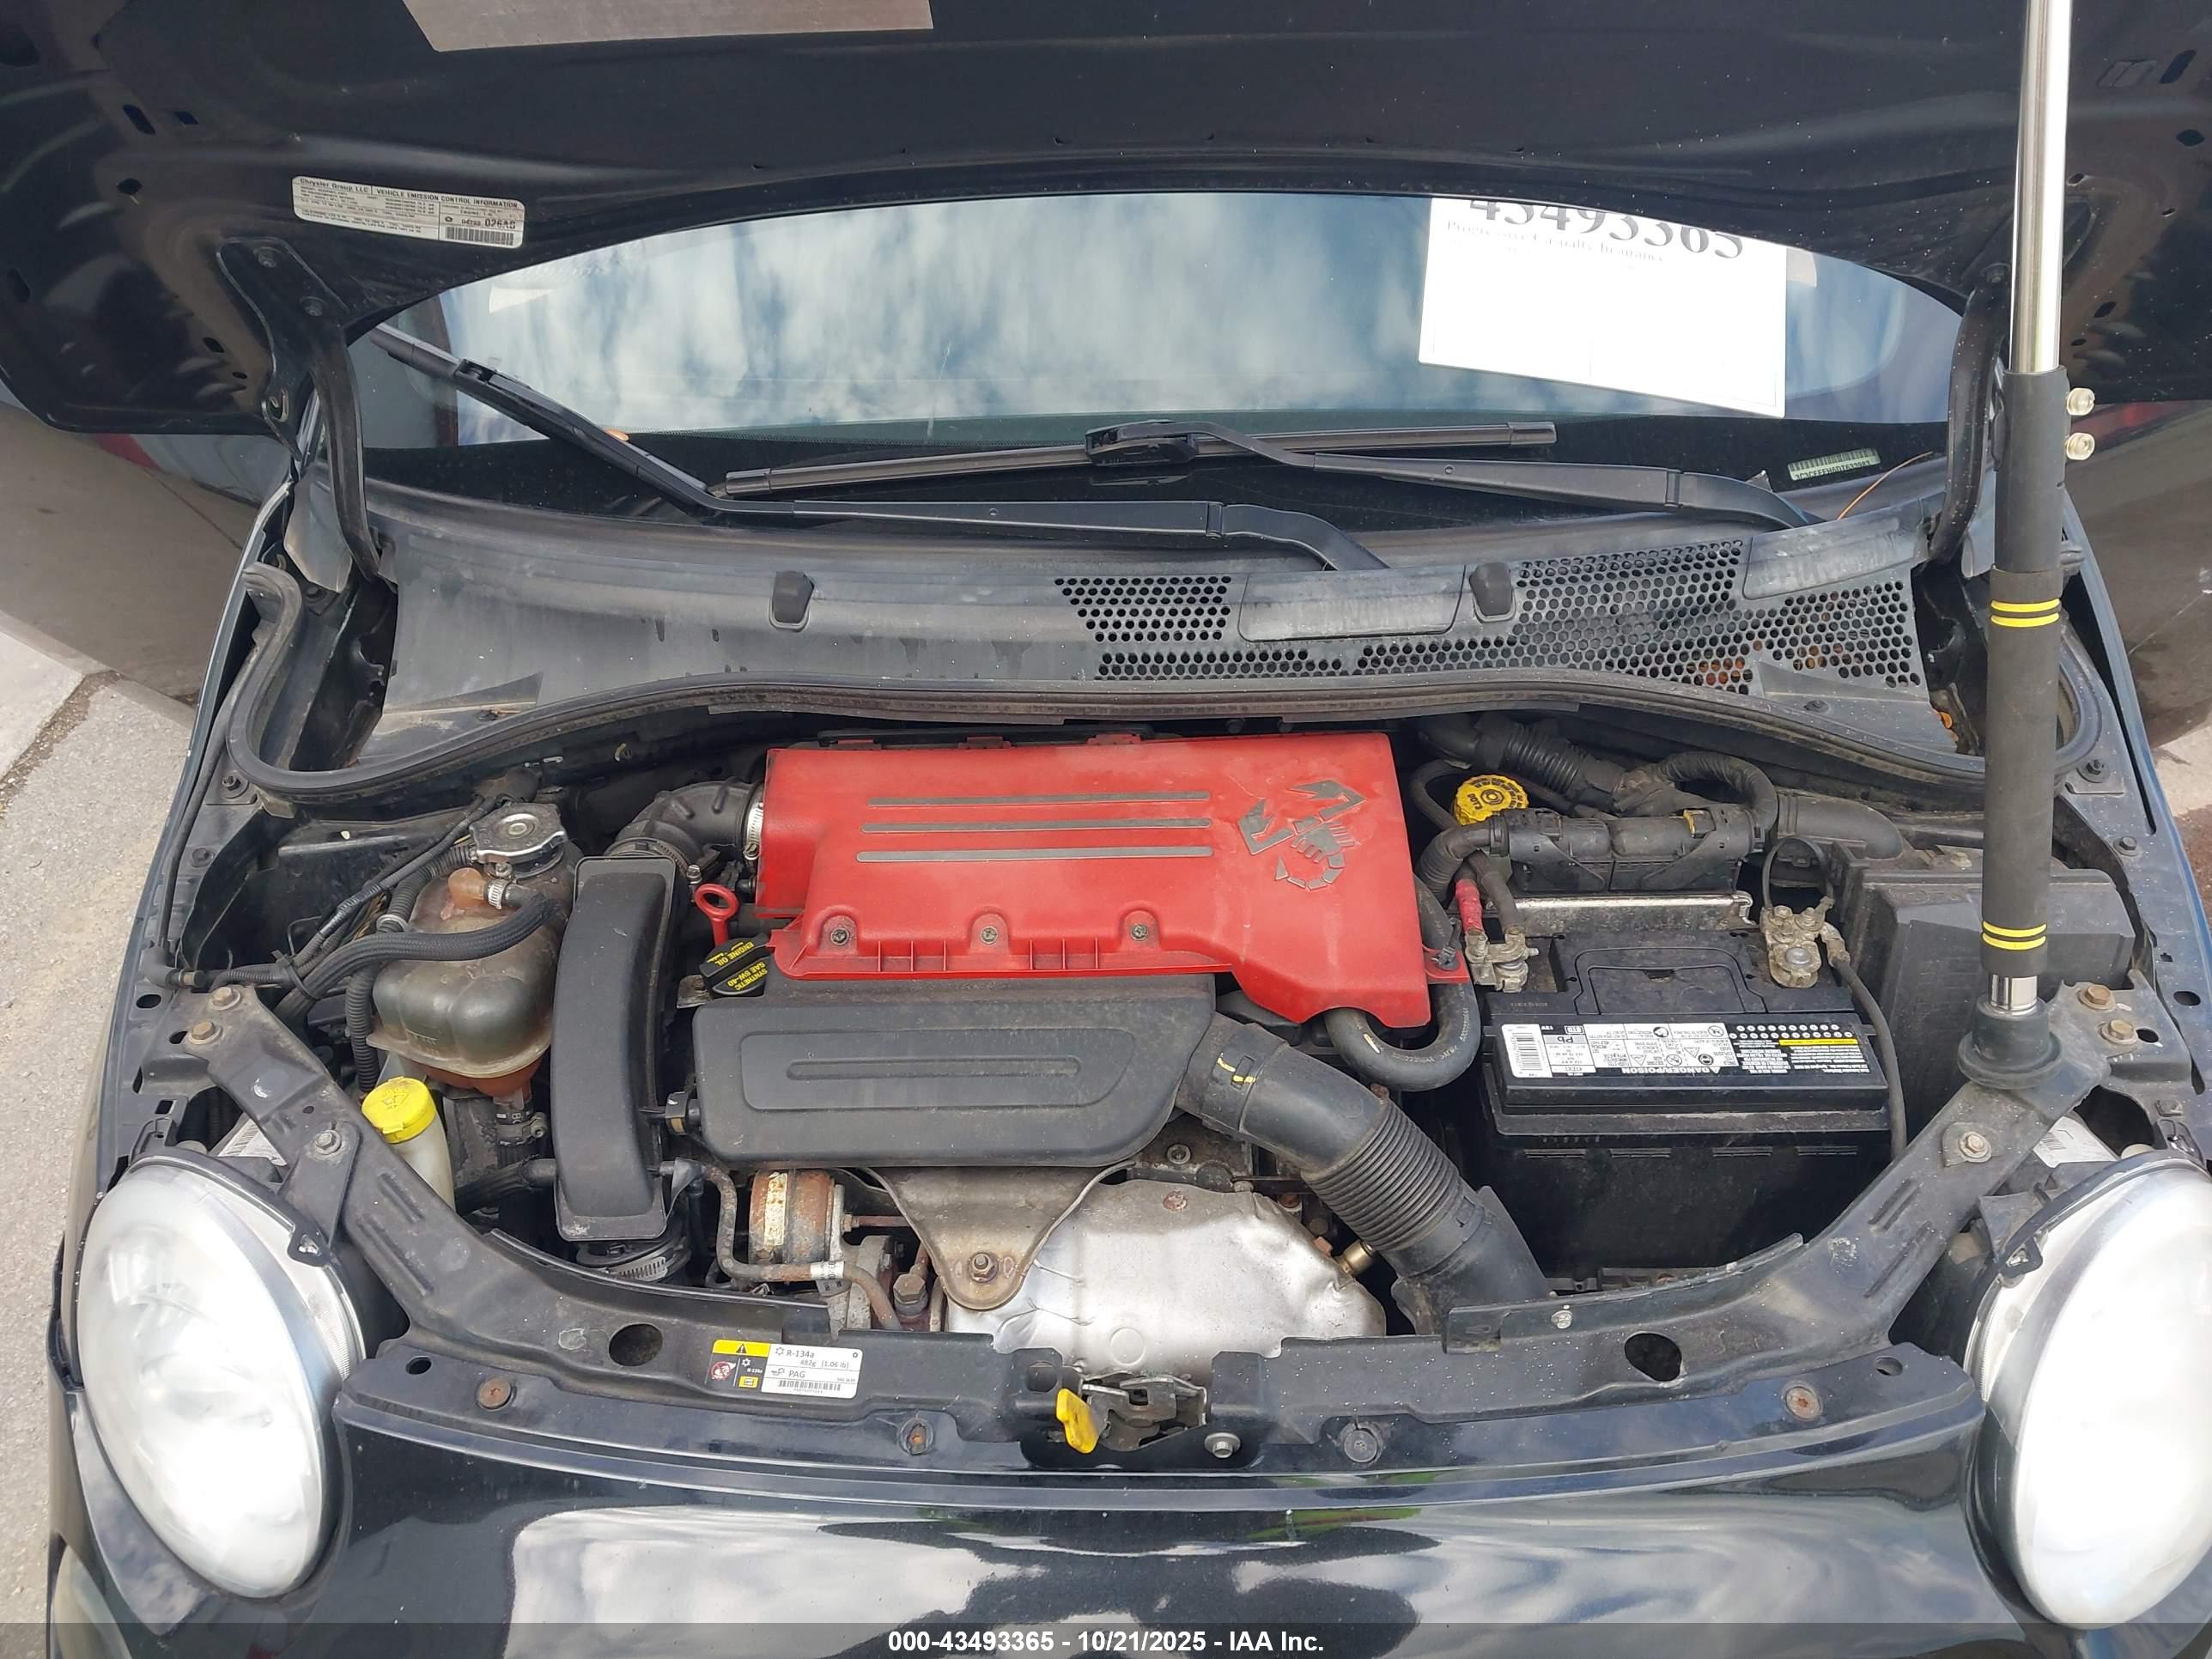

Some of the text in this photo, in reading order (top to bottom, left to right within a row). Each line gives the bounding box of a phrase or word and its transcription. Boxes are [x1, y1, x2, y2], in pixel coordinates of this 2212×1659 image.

[300, 178, 329, 187] Chrysler
[331, 183, 353, 191] Group
[376, 187, 404, 197] VEHICLE
[406, 191, 439, 201] EMISSION
[441, 196, 470, 204] CONTROL
[473, 198, 518, 208] INFORMATION
[714, 941, 754, 967] ENGINE OIL
[726, 961, 766, 987] SAE 5W-40
[734, 968, 768, 990] SYNTHETIC
[786, 1349, 815, 1358] R-134a
[821, 1359, 839, 1368] (1.06
[788, 1370, 806, 1378] PAG
